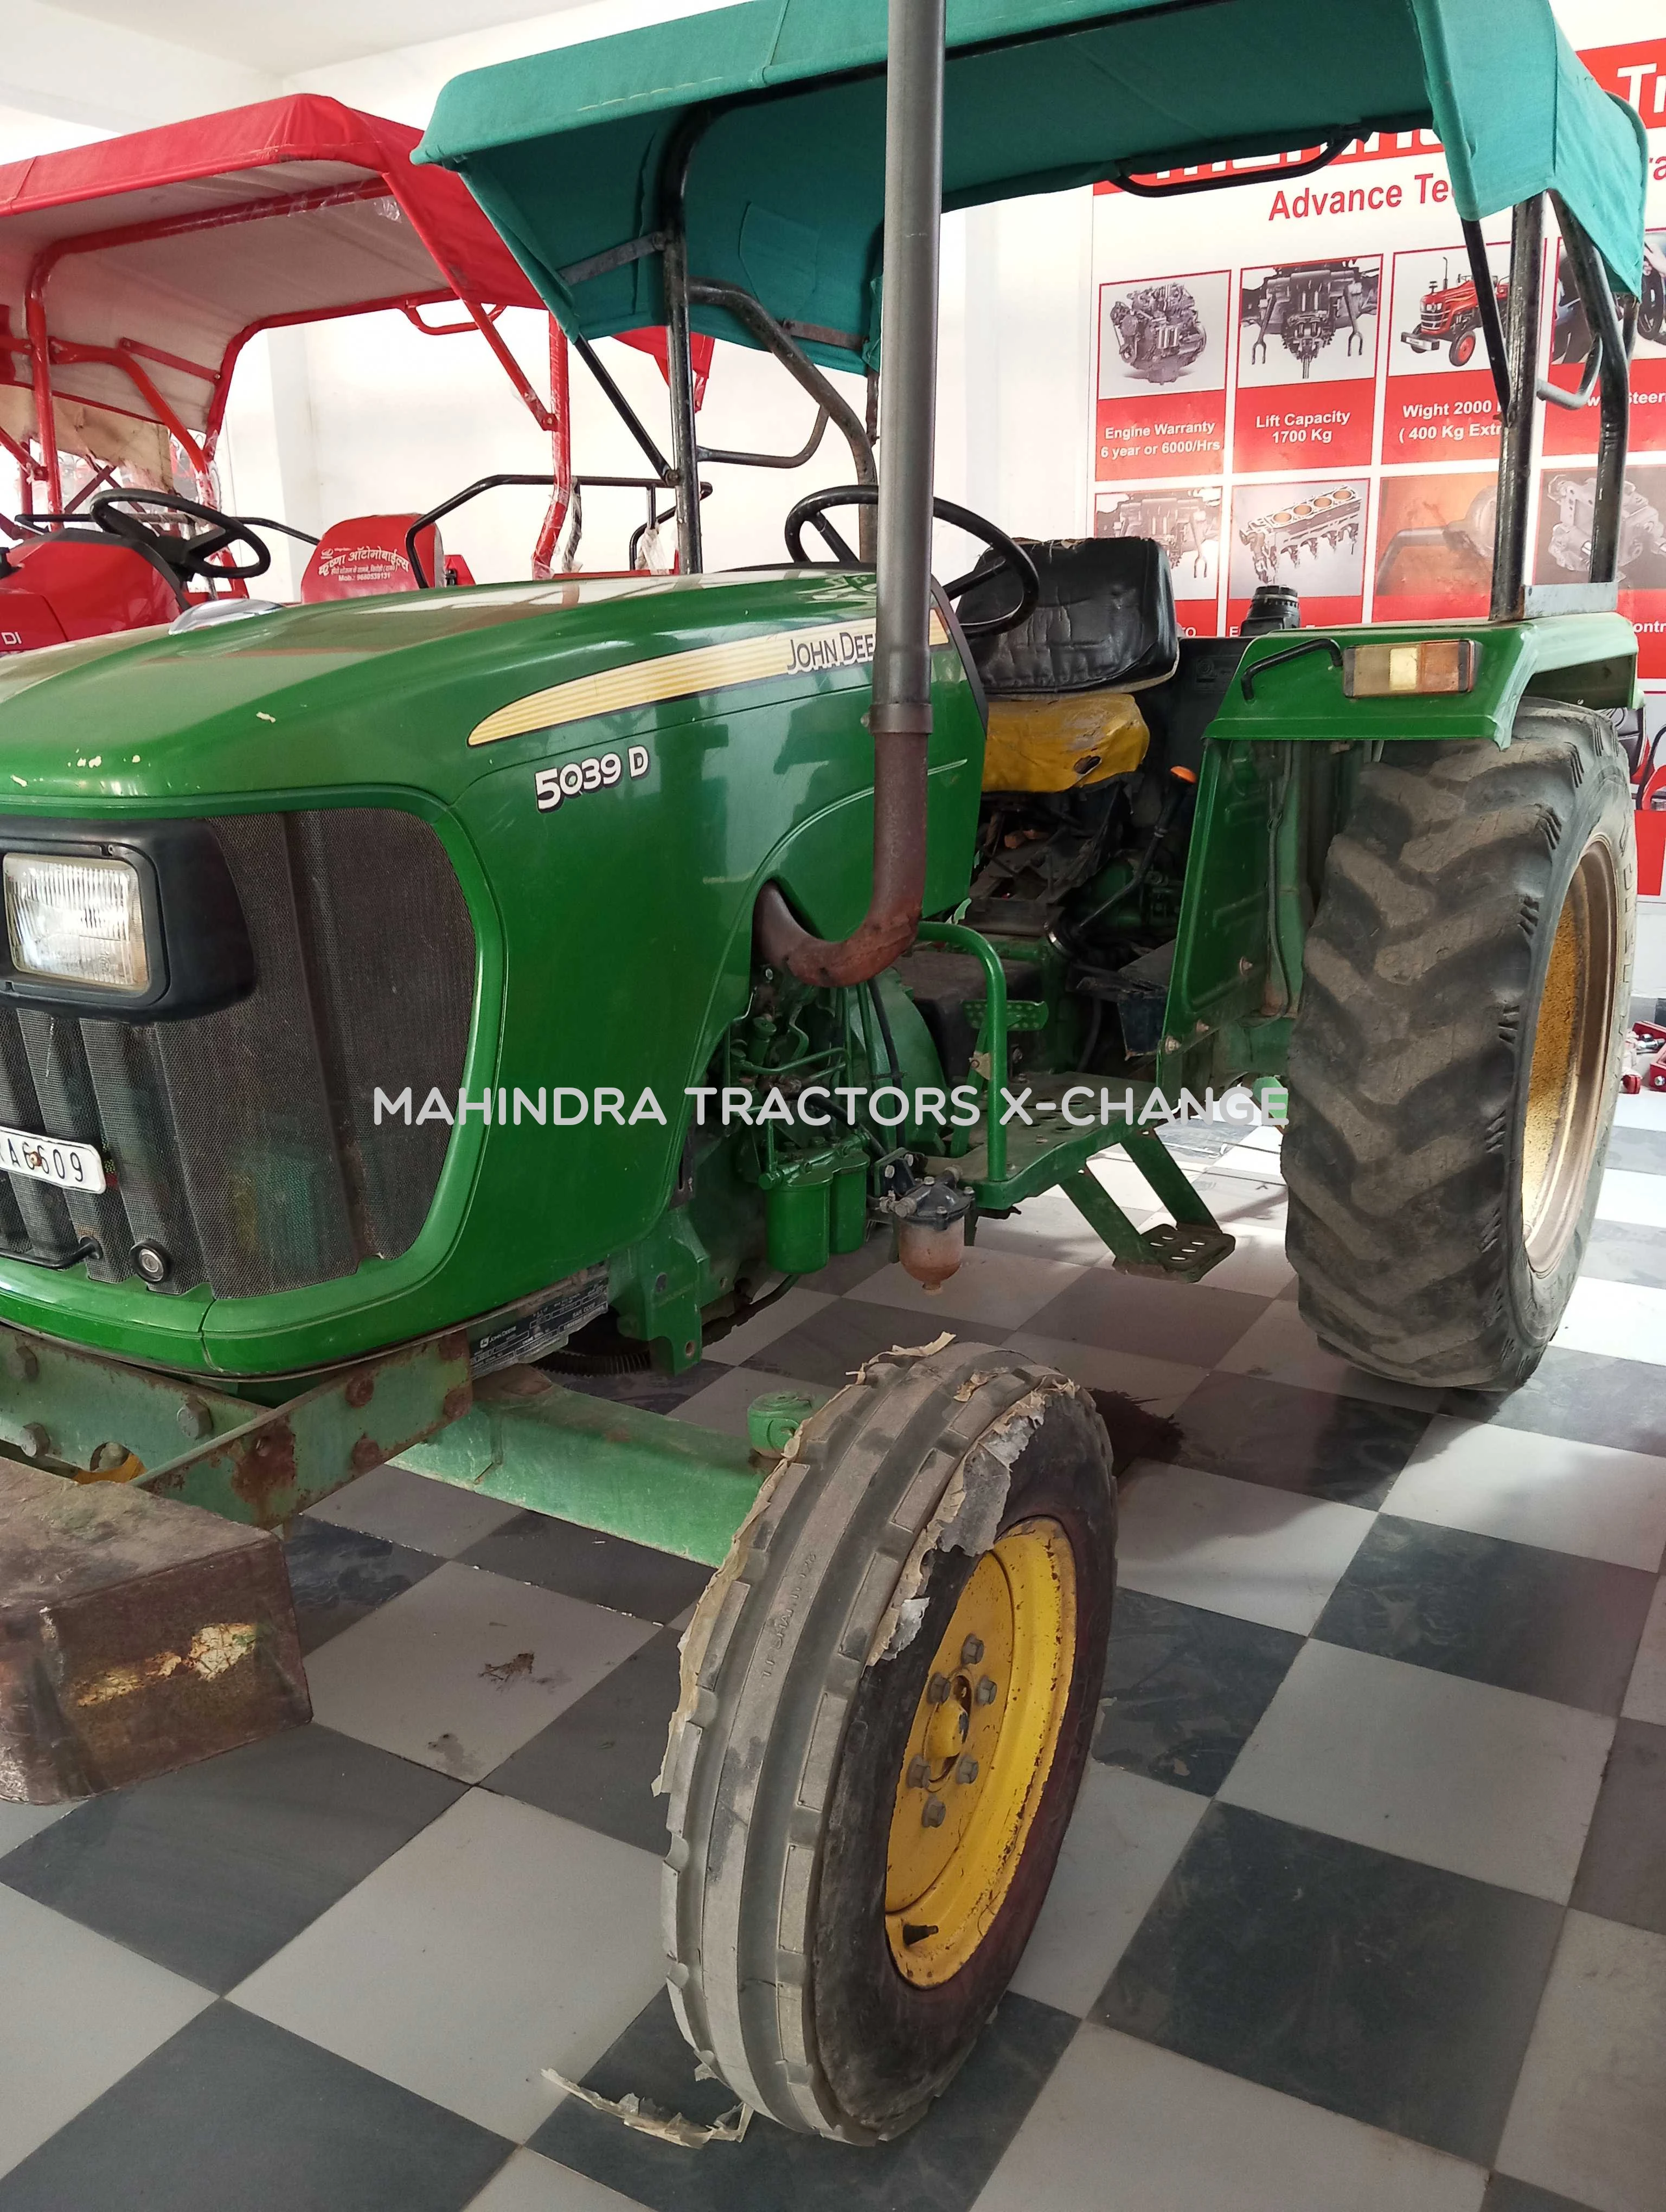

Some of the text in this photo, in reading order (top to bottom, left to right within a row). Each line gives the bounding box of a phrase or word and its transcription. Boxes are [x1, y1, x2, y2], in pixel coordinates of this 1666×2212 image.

[1268, 184, 1402, 221] Advance
[1414, 172, 1456, 204] Te
[1256, 410, 1350, 428] Lift Capacity
[1402, 403, 1450, 420] Wight
[1453, 400, 1492, 415] 2000
[1105, 421, 1215, 440] Engine Warranty
[1272, 428, 1332, 443] 1700 Kg
[1408, 426, 1437, 440] 400
[1441, 425, 1464, 440] Kg
[1100, 440, 1221, 460] 6 year or 6000/Hrs
[1, 632, 22, 645] DI
[787, 632, 876, 671] JOHN DEE
[535, 745, 649, 811] 5039 D
[0, 1137, 84, 1182] A6609
